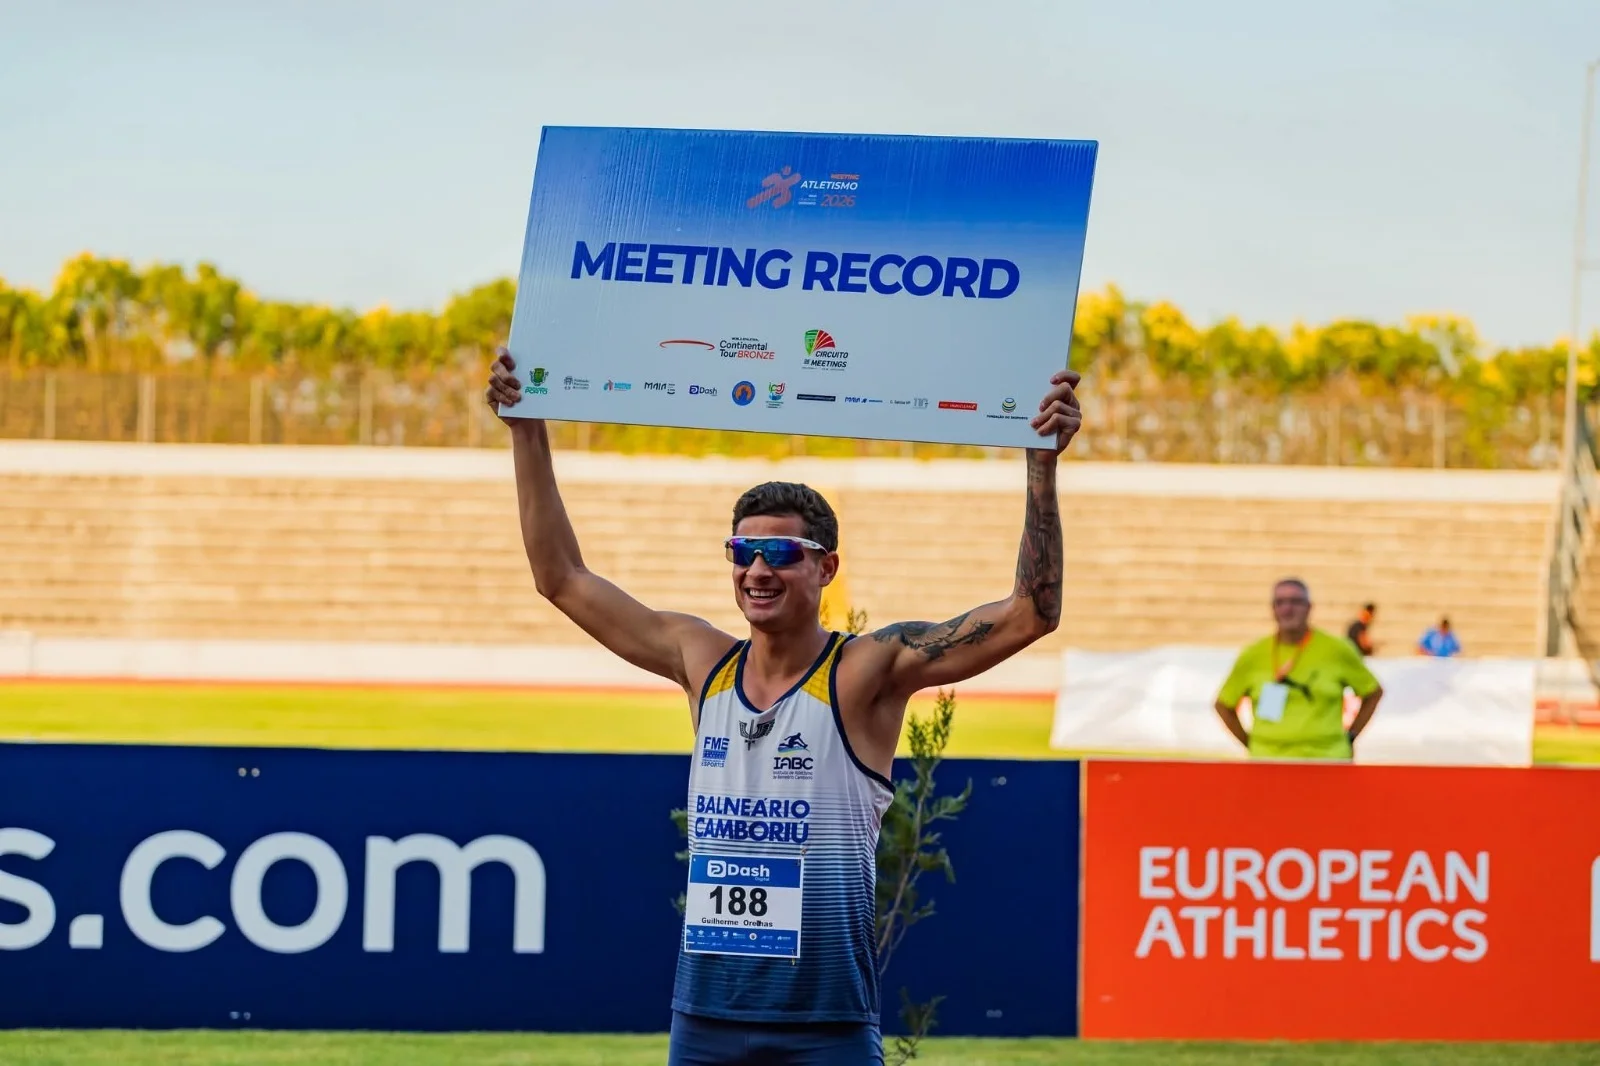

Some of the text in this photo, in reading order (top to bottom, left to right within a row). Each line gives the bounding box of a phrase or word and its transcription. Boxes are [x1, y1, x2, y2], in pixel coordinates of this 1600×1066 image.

[800, 180, 859, 191] ATLETISMO
[820, 194, 856, 207] 2026
[571, 240, 1020, 300] MEETING RECORD
[719, 339, 768, 351] Continental
[815, 350, 849, 359] CIRCUITO
[810, 359, 847, 368] MEETINGS
[699, 386, 718, 395] Dash
[703, 736, 730, 750] FME
[773, 757, 814, 770] IABC
[696, 795, 811, 819] BALNEÁRIO
[694, 816, 809, 844] CAMBORIÚ
[727, 863, 770, 878] Dash
[1138, 846, 1491, 904] EUROPEAN
[709, 885, 768, 917] 188
[701, 917, 739, 926] Guilherme
[1134, 905, 1491, 963] ATHLETICS
